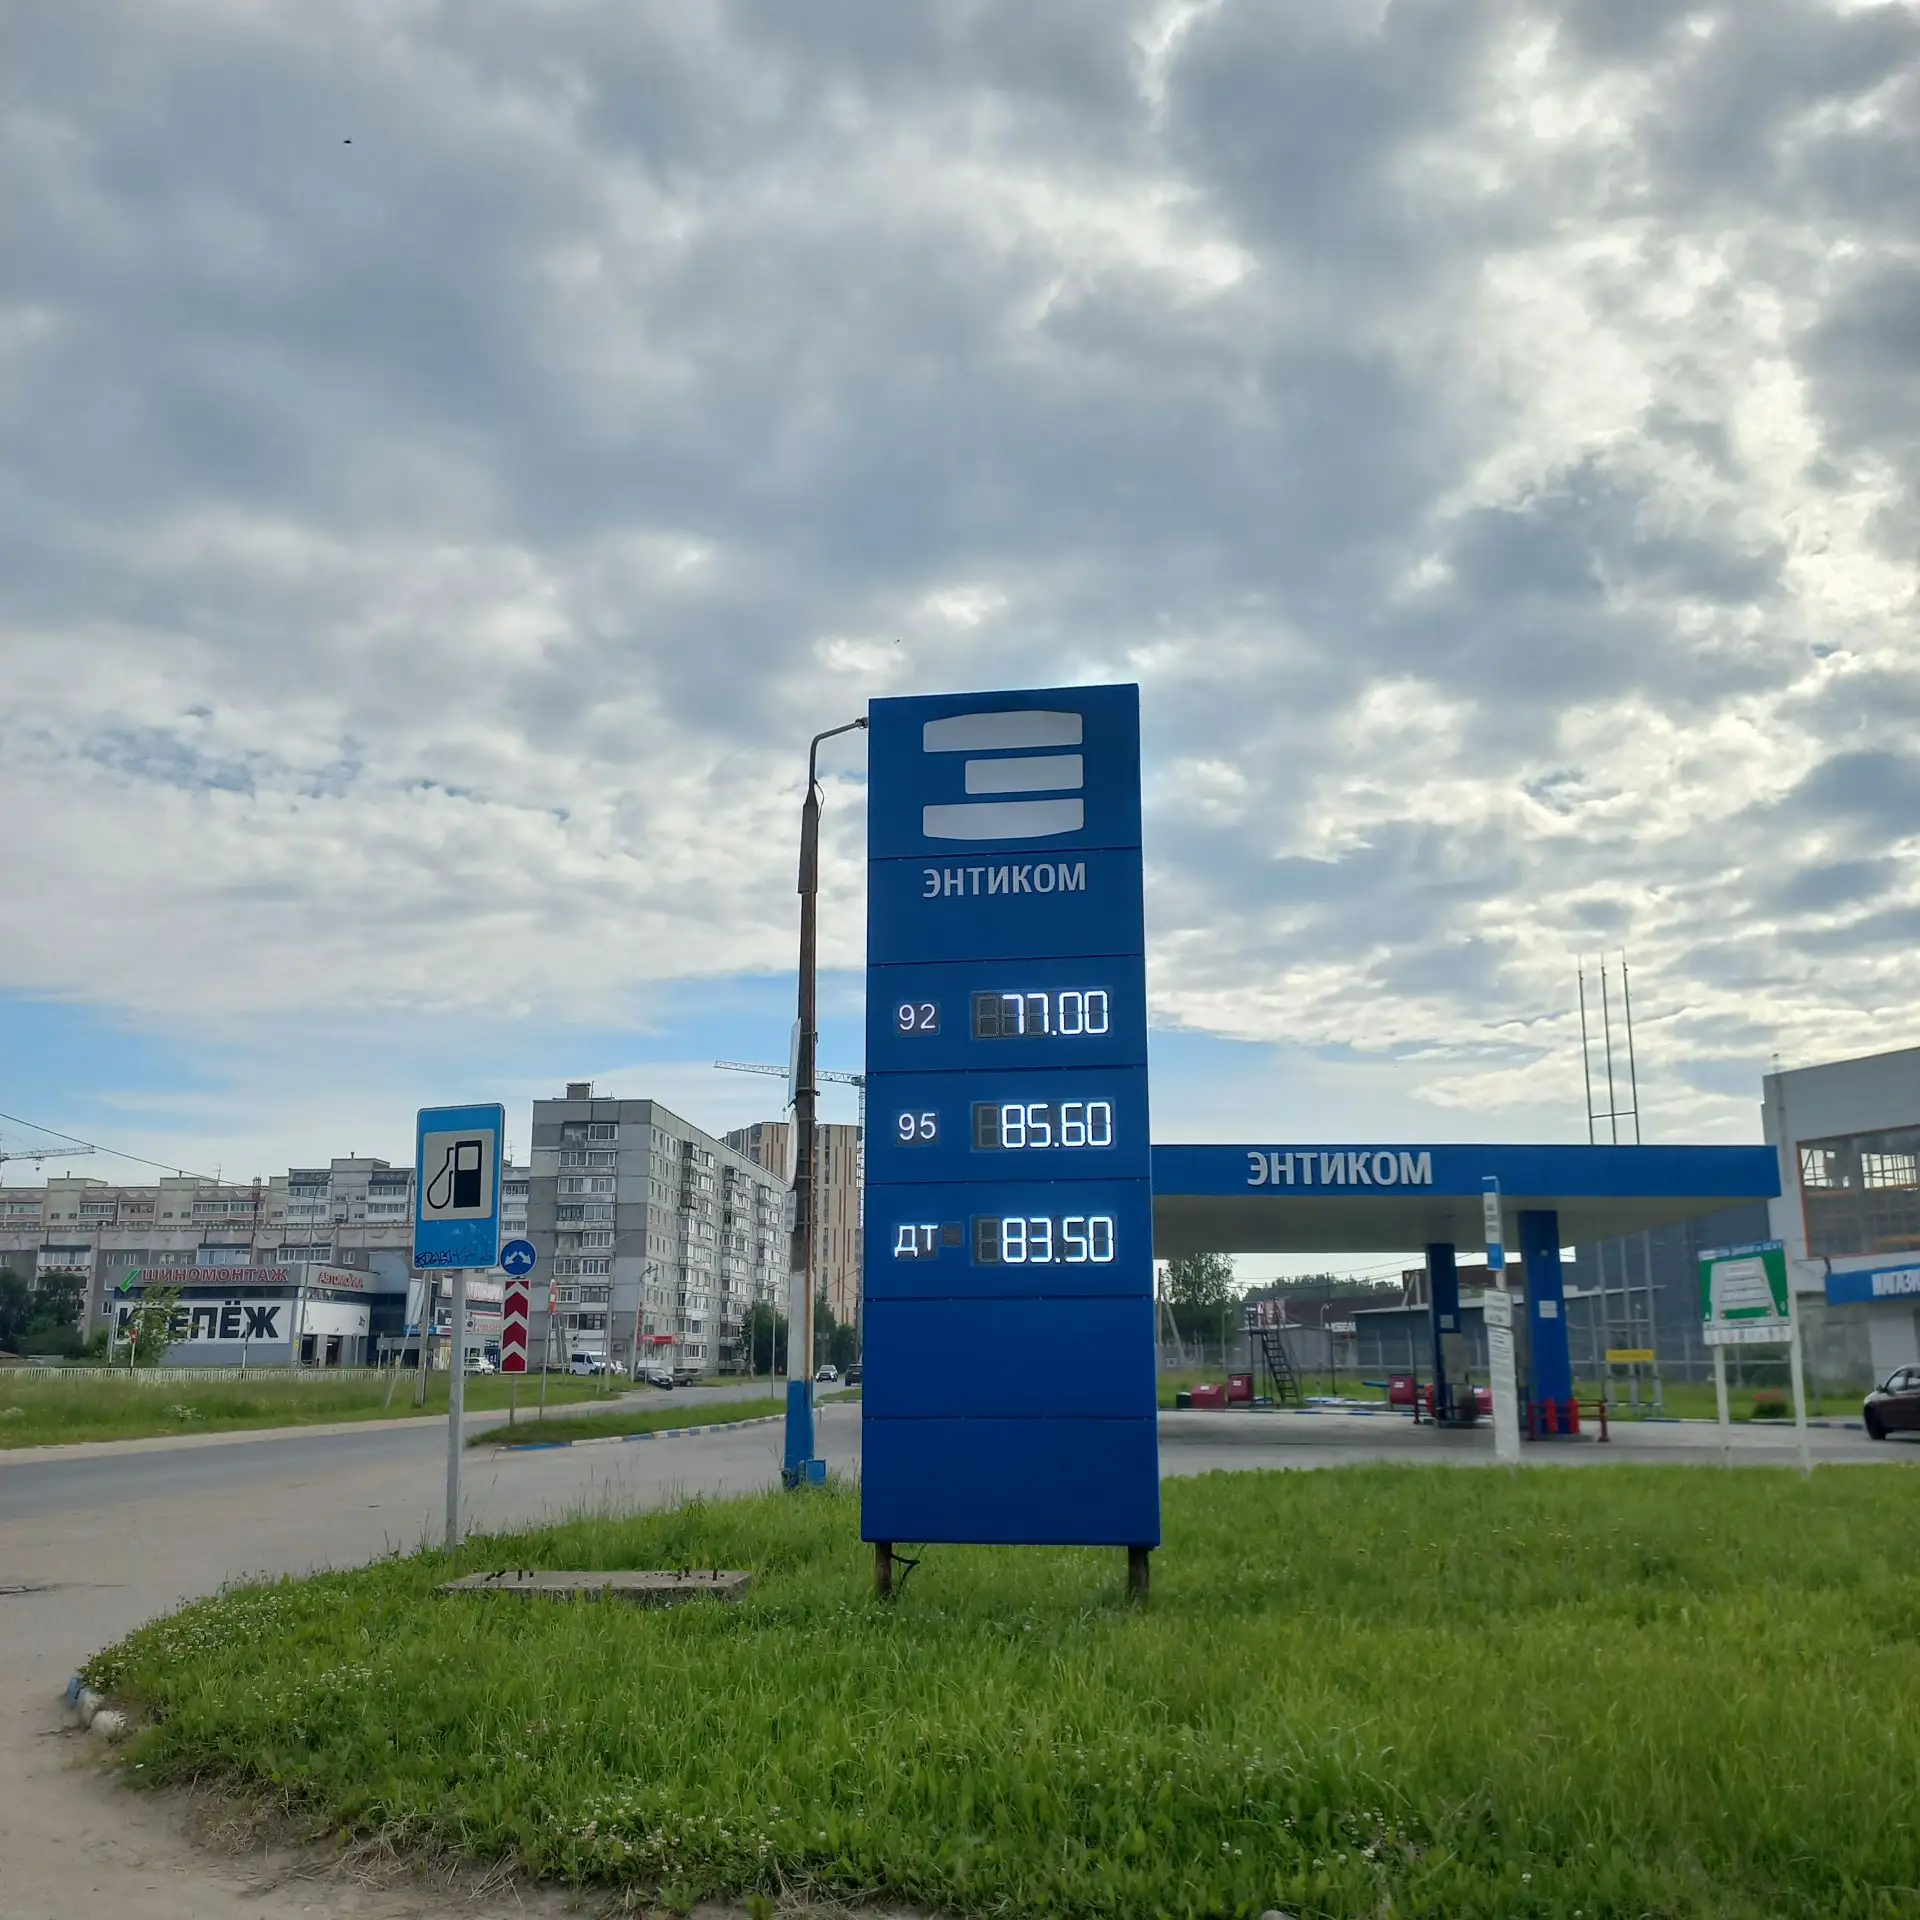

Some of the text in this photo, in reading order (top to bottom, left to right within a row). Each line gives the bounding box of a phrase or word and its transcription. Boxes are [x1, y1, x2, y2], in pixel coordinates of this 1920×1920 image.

[923, 862, 1086, 898] ЭНТИКОМ
[898, 990, 1109, 1036] 92 77.00
[898, 1102, 1112, 1149] 95 85.60
[1247, 1151, 1433, 1186] ЭНТИКОМ
[894, 1216, 1114, 1264] ДТ 83.50
[142, 1267, 289, 1284] ШИНОМОНТАЖ
[117, 1300, 281, 1339] КЕПЁЖ
